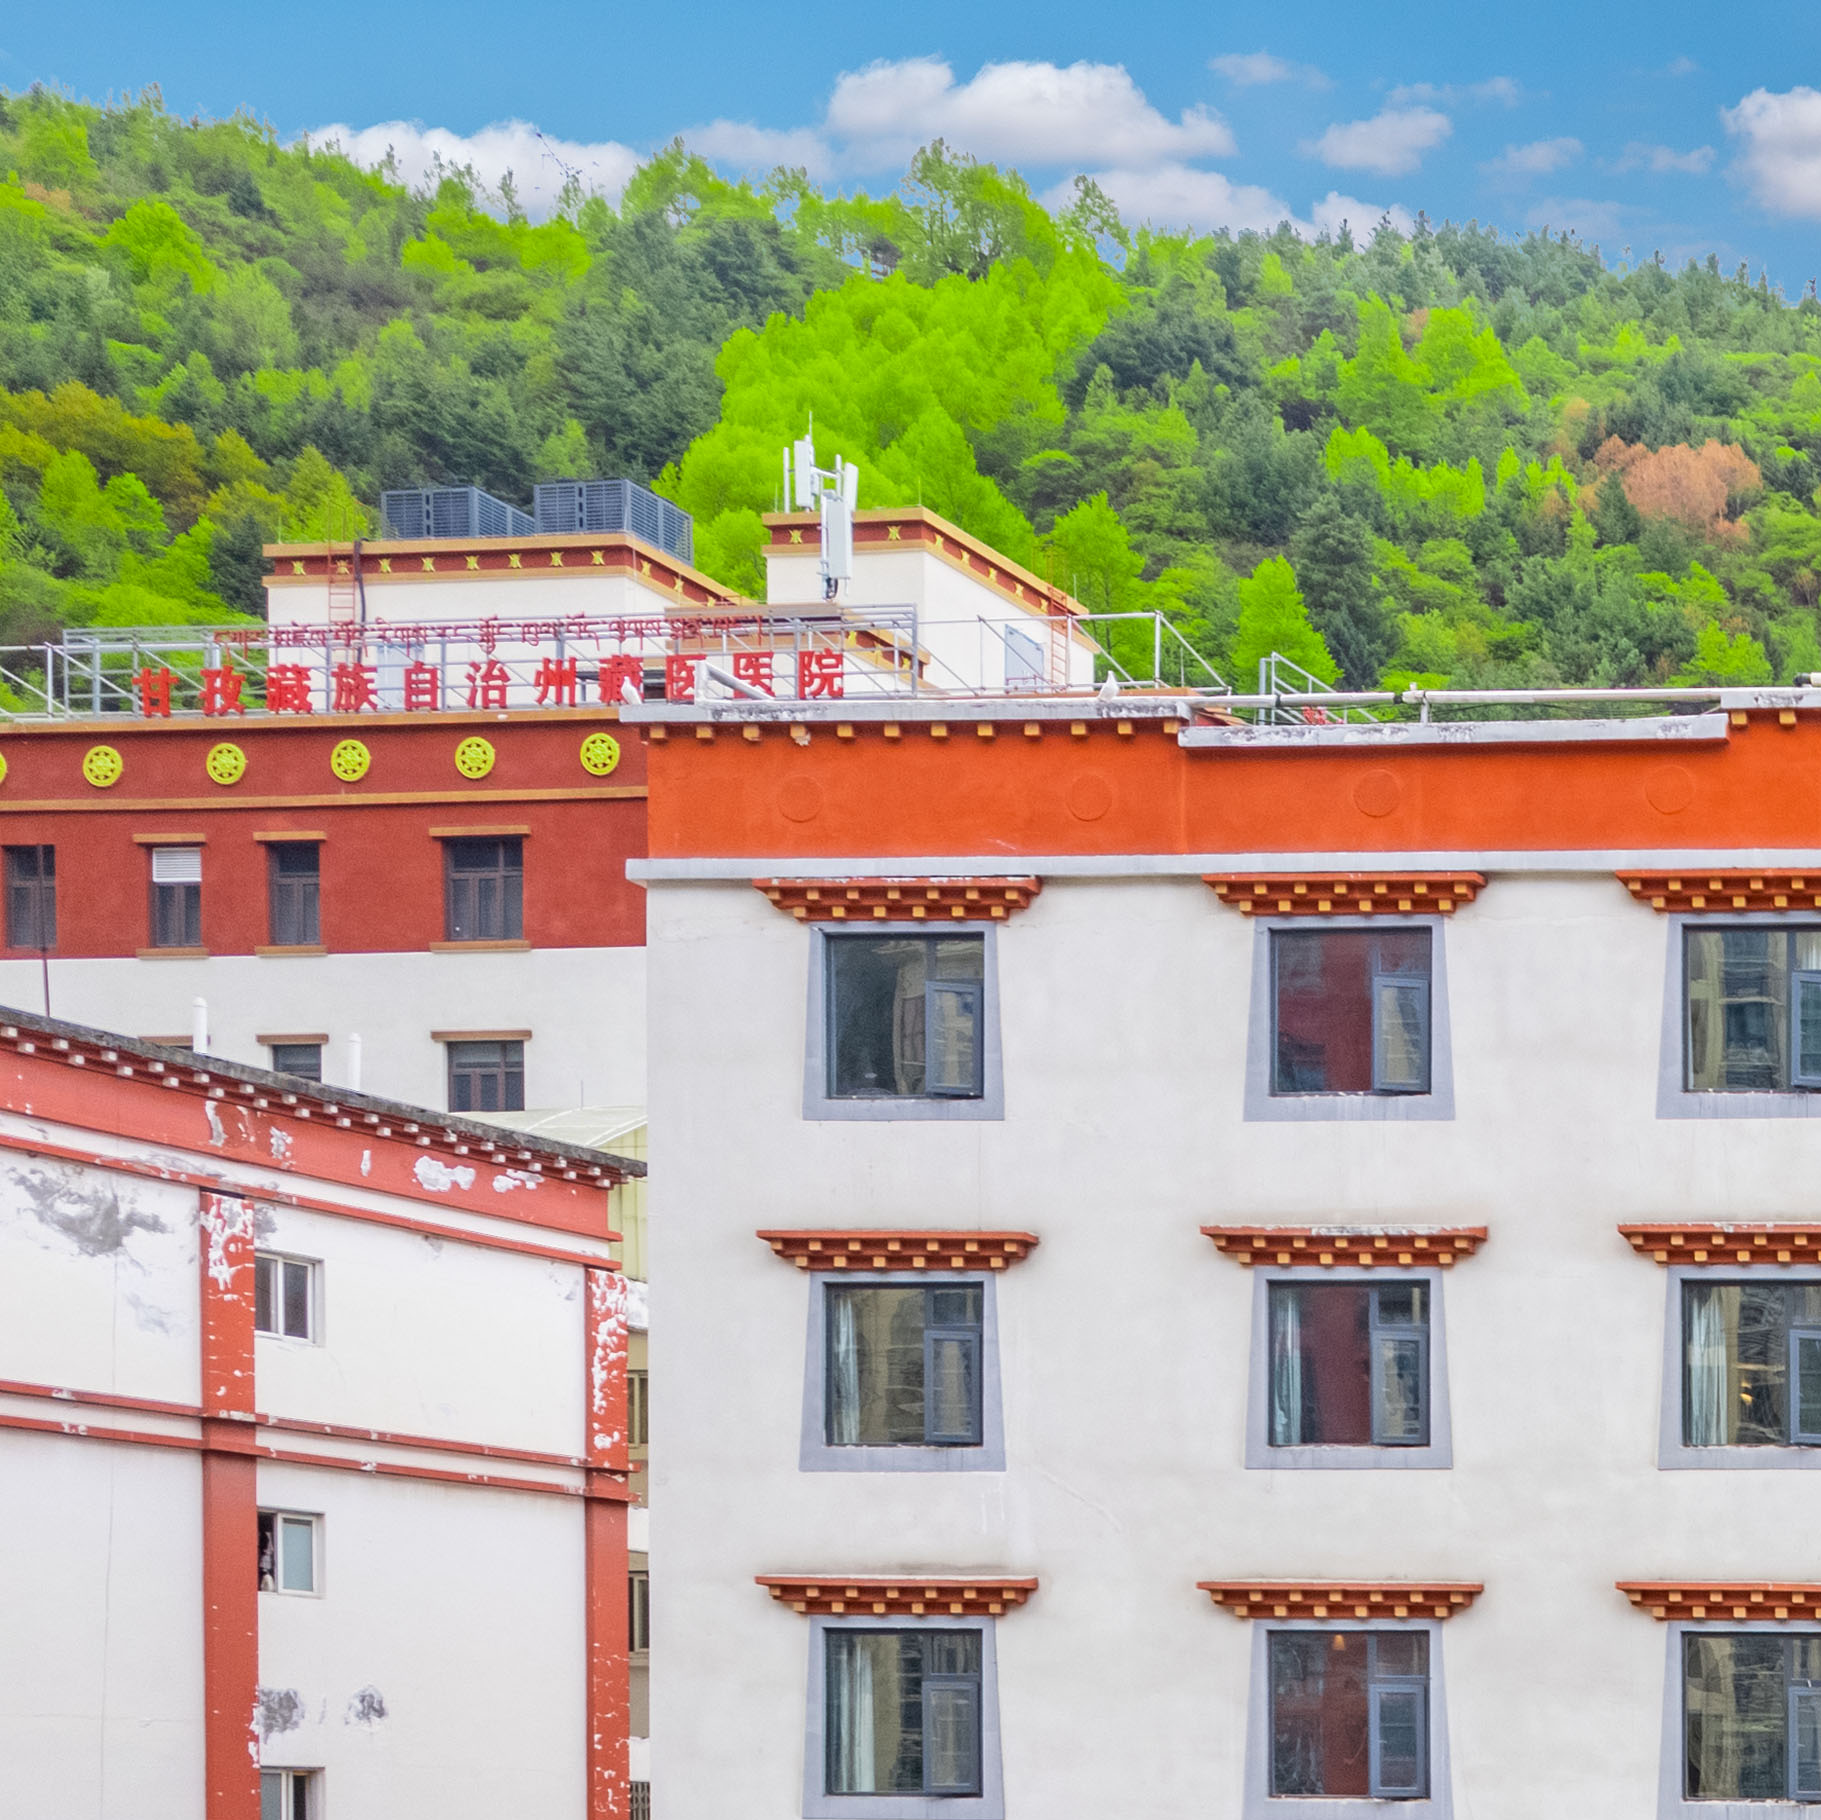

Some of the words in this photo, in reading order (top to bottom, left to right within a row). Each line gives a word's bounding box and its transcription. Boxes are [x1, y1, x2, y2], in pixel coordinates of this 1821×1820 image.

[132, 648, 844, 717] 甘孜藏族自治州藏医医院
